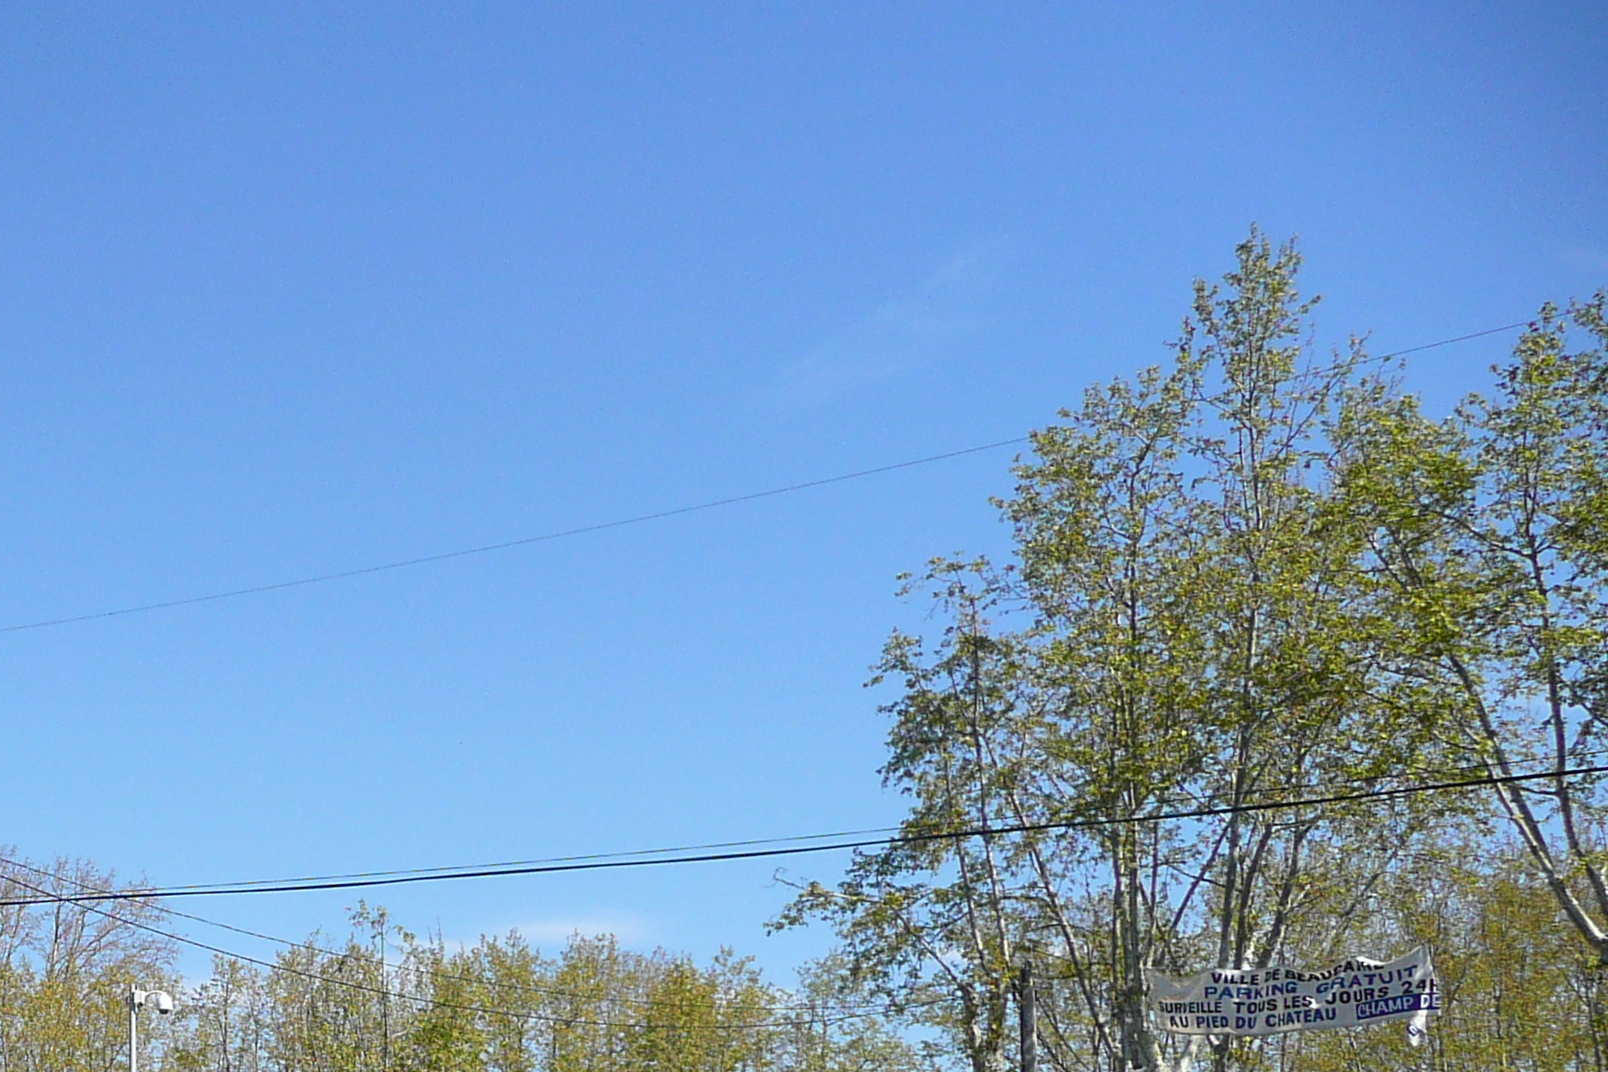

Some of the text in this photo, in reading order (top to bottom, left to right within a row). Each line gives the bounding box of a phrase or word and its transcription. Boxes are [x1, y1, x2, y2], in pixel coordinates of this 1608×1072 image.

[1204, 965, 1418, 1000] PARKING GRATUIT
[1210, 972, 1259, 986] VILLE
[1264, 968, 1280, 982] DE
[1233, 999, 1278, 1014] TOUS
[1284, 995, 1314, 1009] LES
[1324, 986, 1390, 1005] JOURS
[1357, 996, 1414, 1017] CHAMP
[1170, 1007, 1337, 1028] AU PIED DU CHATEAU
